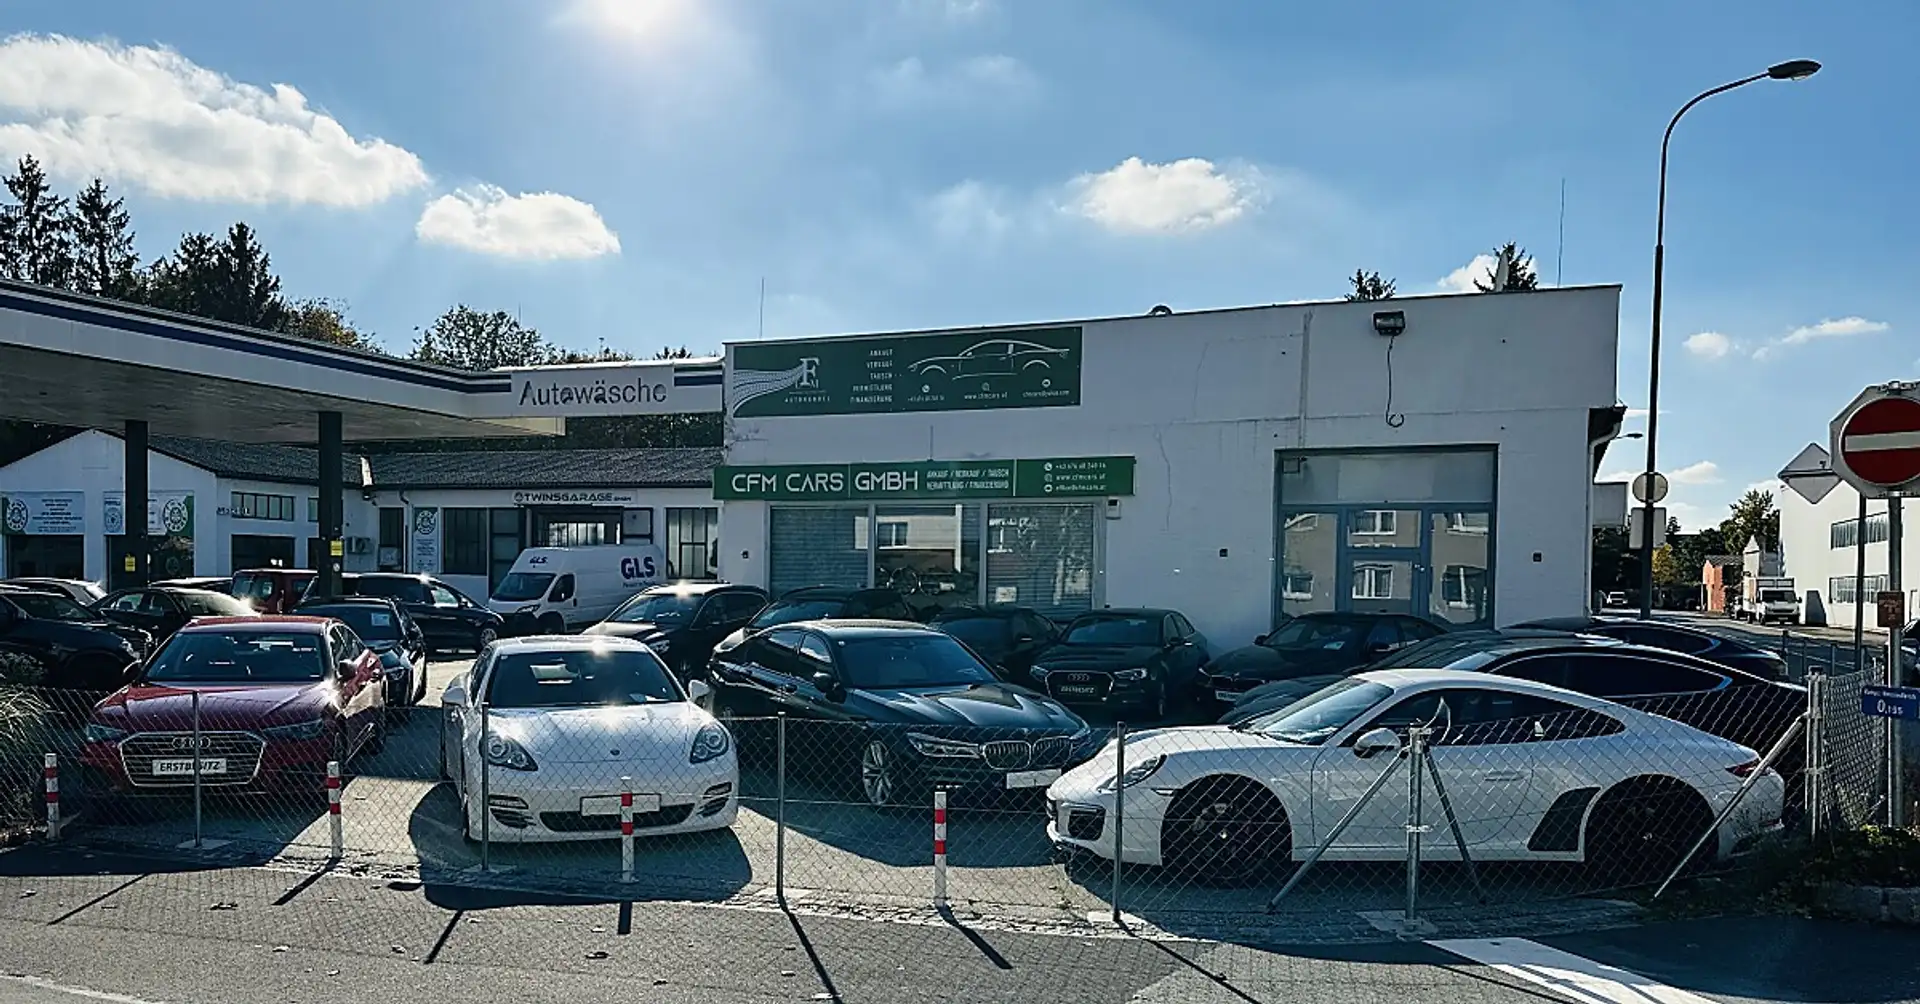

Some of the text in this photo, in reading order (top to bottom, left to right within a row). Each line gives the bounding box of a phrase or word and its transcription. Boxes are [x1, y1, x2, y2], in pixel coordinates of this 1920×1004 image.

[519, 377, 667, 405] Autowäsche
[732, 470, 919, 492] CFM CARS GMBH
[524, 492, 613, 502] TWINSGARAGE
[530, 556, 548, 564] GLS
[620, 556, 656, 579] GLS
